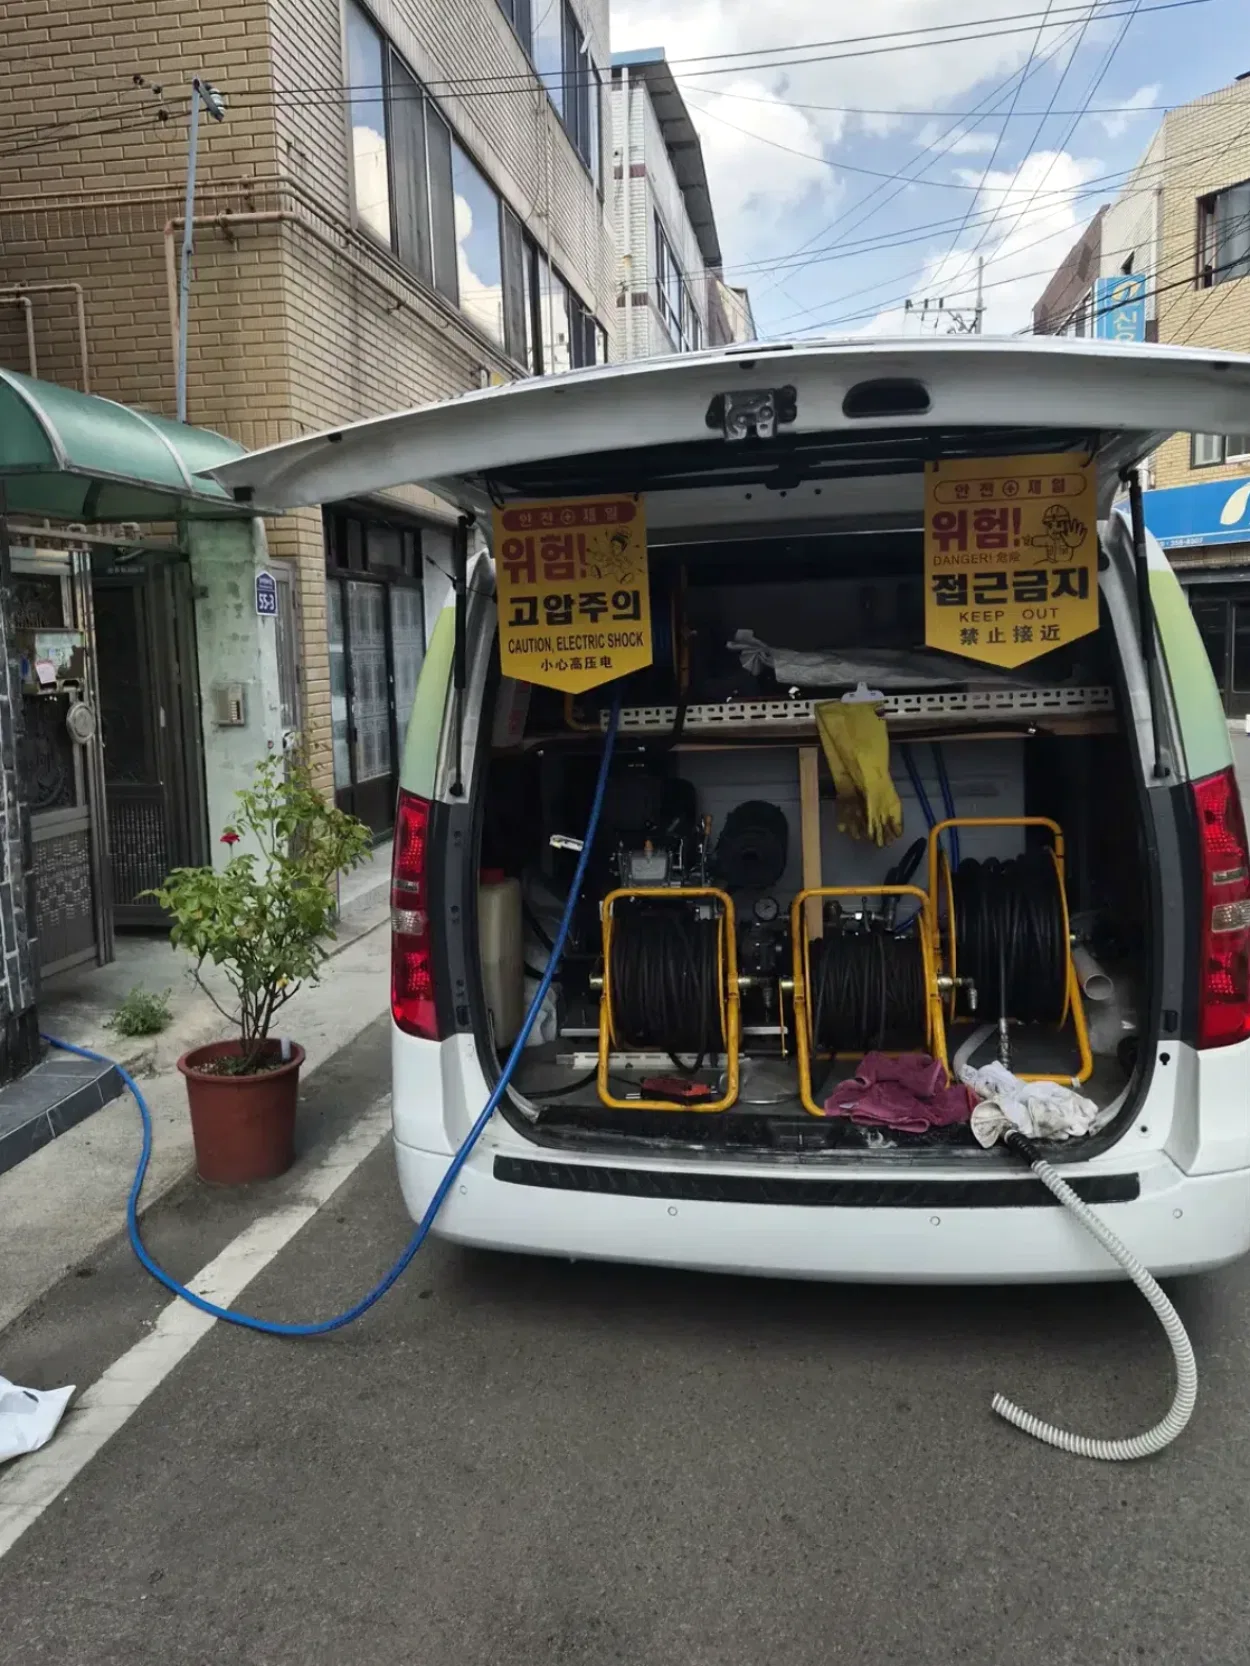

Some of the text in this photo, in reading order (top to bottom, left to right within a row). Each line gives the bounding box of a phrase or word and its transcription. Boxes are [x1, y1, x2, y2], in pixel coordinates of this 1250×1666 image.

[931, 506, 1022, 552] 위험!
[501, 533, 587, 585] 위험!
[933, 554, 993, 566] DANGER!
[932, 566, 1089, 607] 접근금지
[508, 590, 641, 627] 고압주의
[959, 608, 1060, 623] KEEP OUT
[508, 631, 644, 654] CAUTION, ELECTRIC SHOCK
[959, 624, 1061, 645] 禁止接近
[540, 656, 613, 672] 小心高压电
